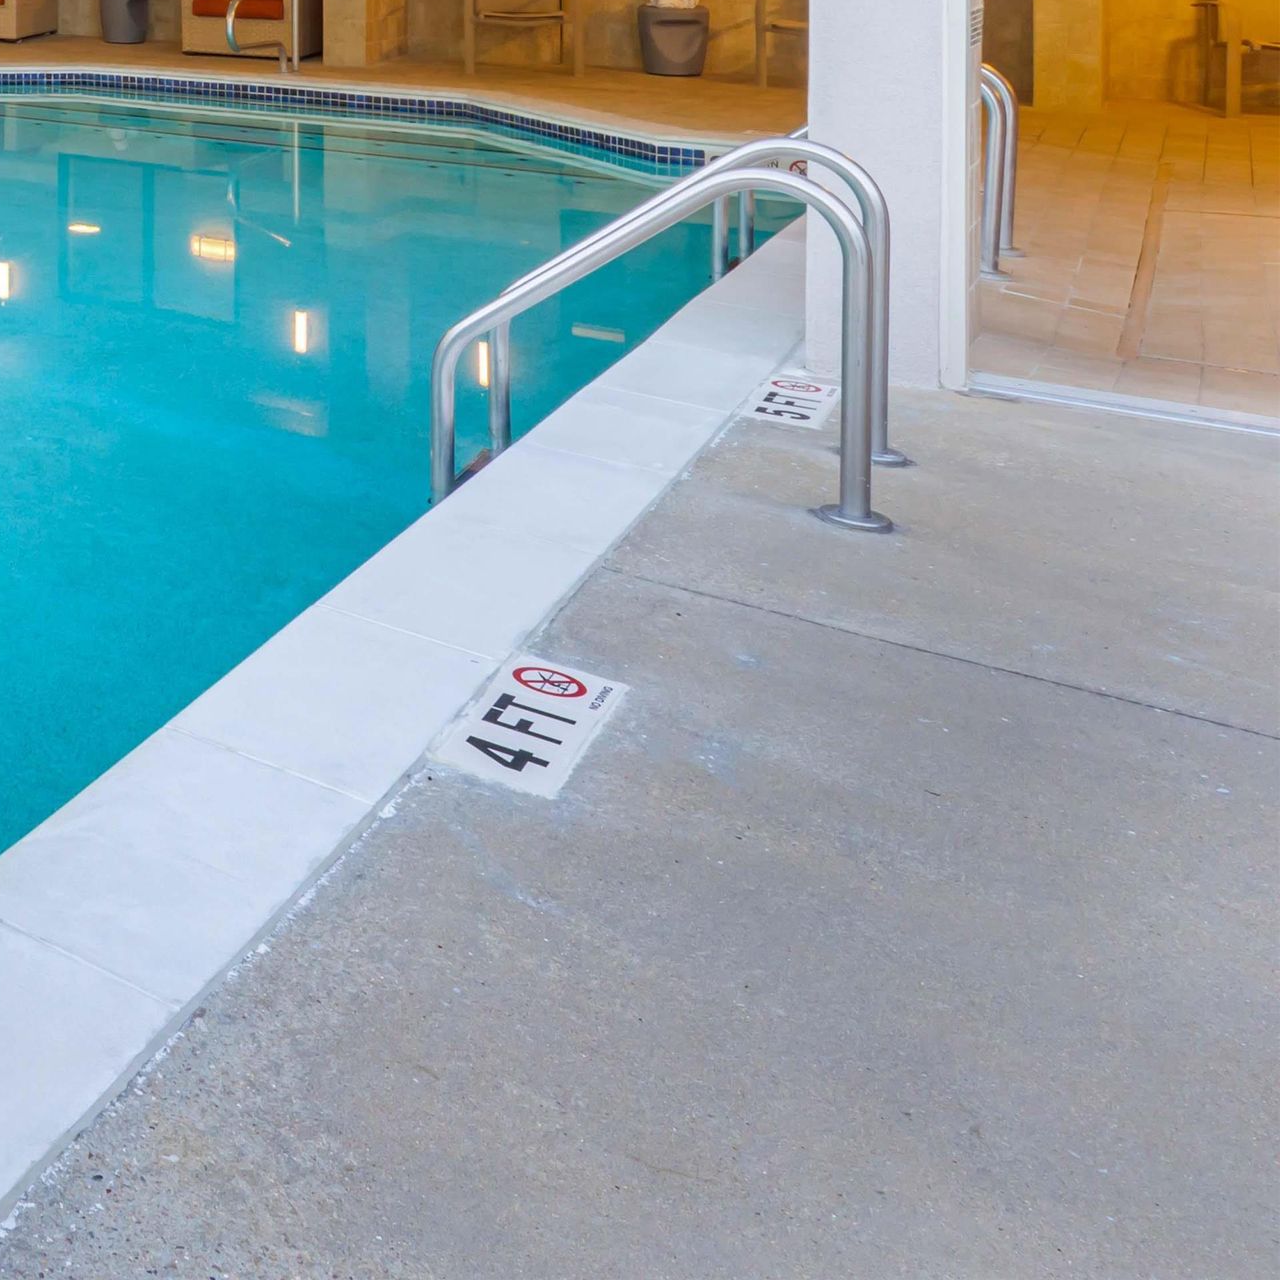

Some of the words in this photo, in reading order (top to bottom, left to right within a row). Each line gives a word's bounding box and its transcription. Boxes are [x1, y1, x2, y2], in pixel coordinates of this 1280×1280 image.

[754, 406, 811, 420] 5
[762, 391, 822, 410] FT
[481, 692, 577, 745] FT
[466, 735, 550, 772] 4
